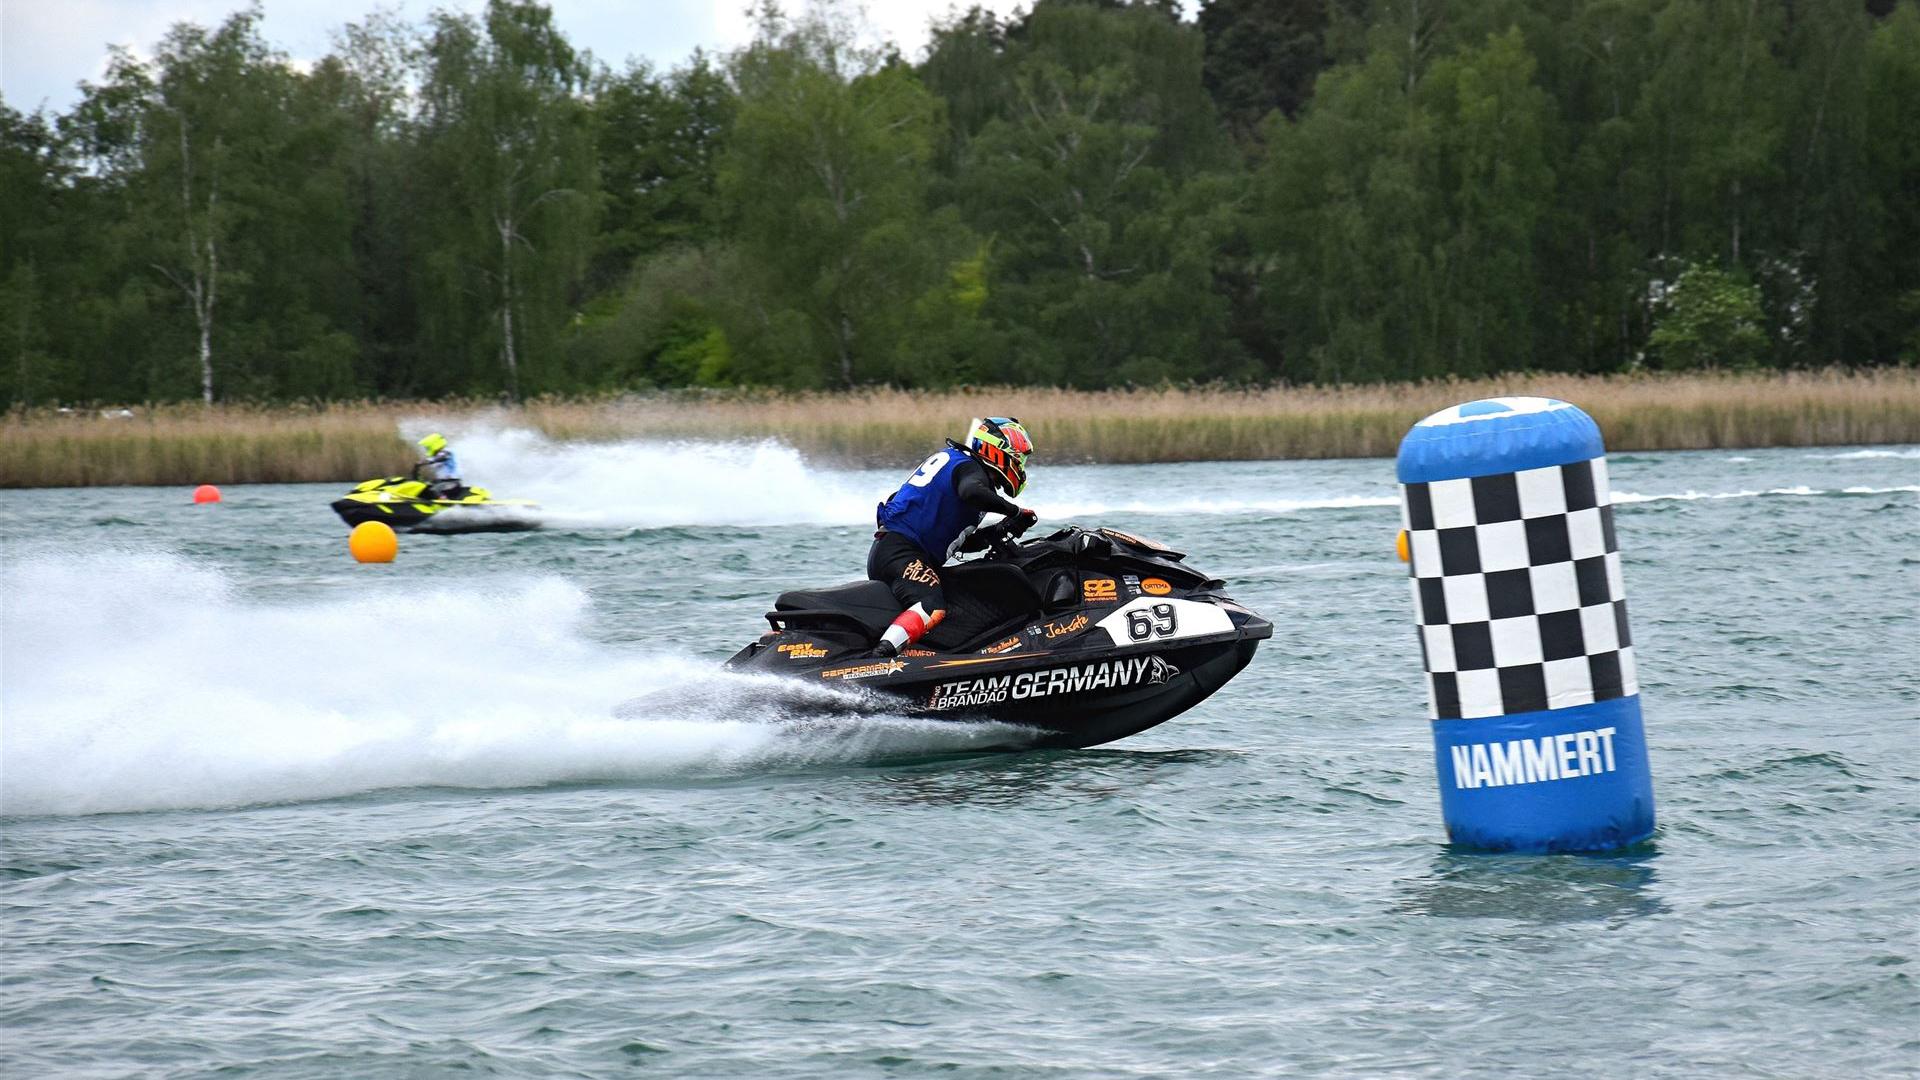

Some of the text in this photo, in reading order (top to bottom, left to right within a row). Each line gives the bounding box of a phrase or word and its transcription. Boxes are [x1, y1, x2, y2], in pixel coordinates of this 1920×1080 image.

[905, 451, 950, 488] 9
[902, 567, 940, 587] PILOT
[1124, 603, 1179, 643] 69
[900, 649, 937, 658] AMMERT
[942, 675, 1011, 697] TEAM
[1011, 656, 1150, 699] GERMANY
[937, 690, 1007, 709] BRANDAO
[1451, 726, 1617, 789] NAMMERT
